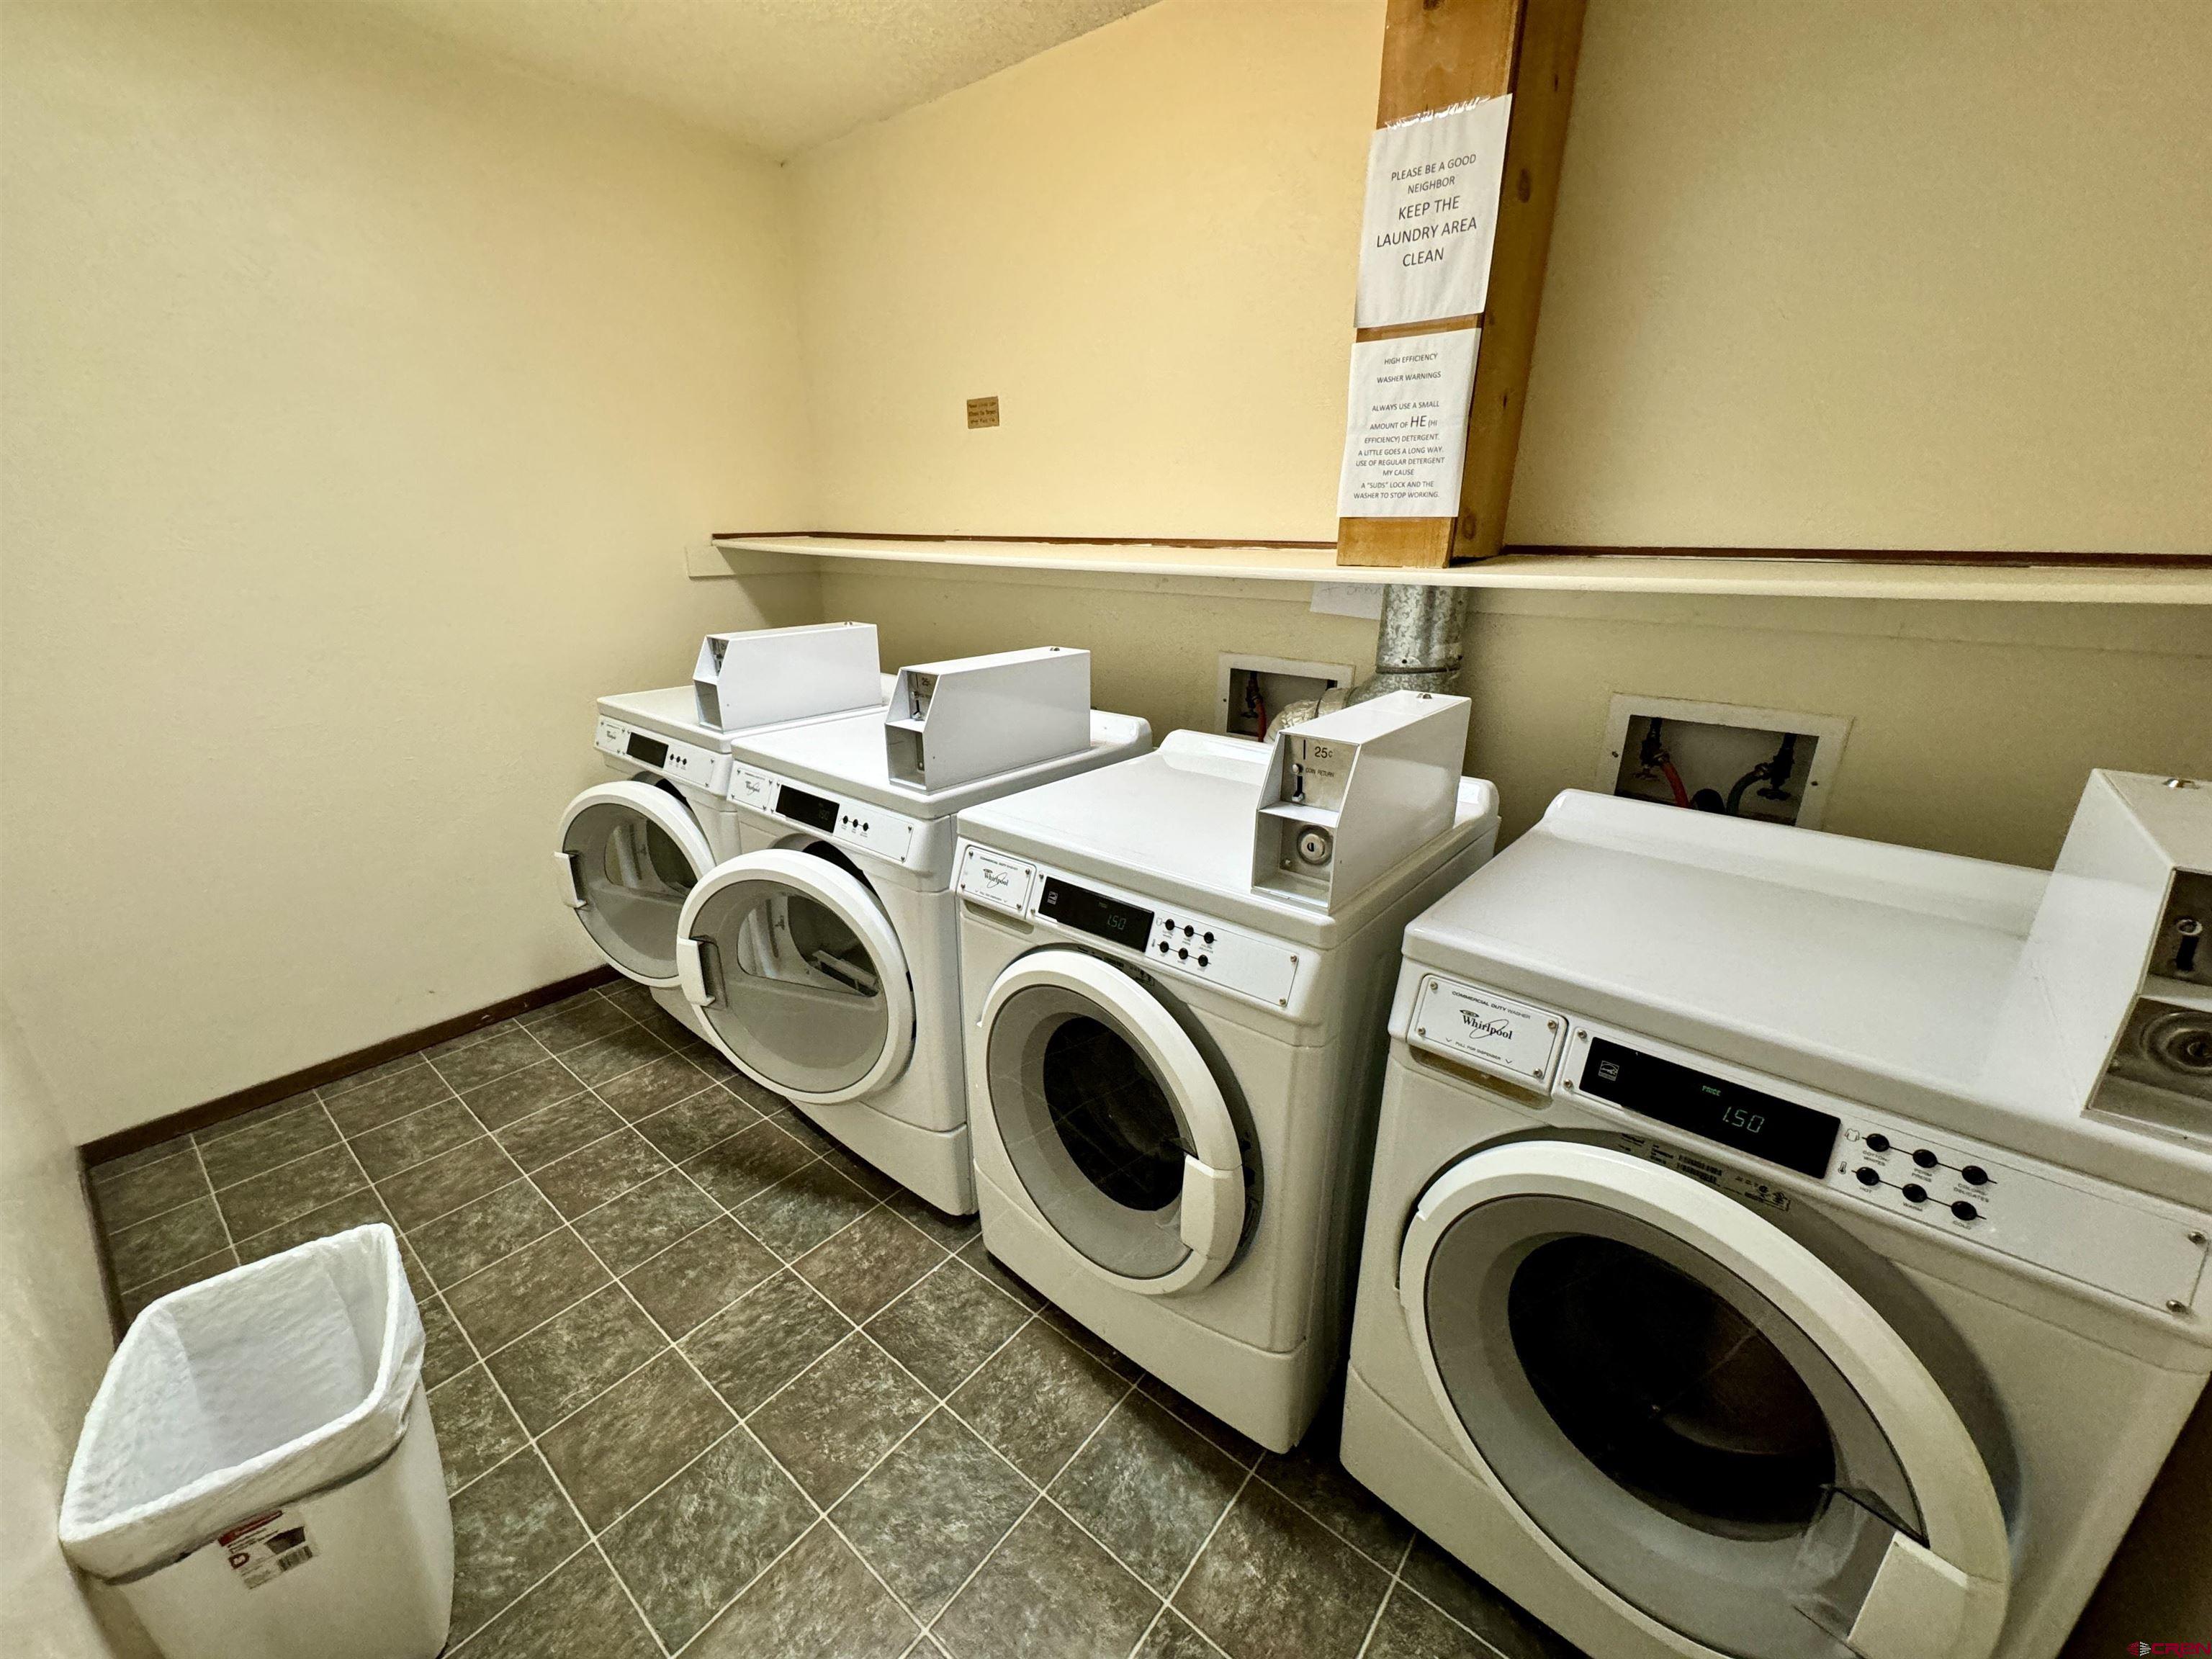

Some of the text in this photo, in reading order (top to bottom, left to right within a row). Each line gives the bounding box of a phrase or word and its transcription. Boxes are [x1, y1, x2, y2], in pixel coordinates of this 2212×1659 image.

[1391, 154, 1477, 181] PLEASE BE A GOOD
[1408, 176, 1455, 194] NEIGHBOR
[1398, 195, 1460, 220] KEEP THE
[1376, 217, 1477, 248] LAUNDRY AREA
[1402, 248, 1444, 267] CLEAN
[1402, 353, 1438, 364] EFFICIENCY
[1405, 371, 1442, 381] WARNINGS
[1372, 403, 1398, 412] ALWAYS
[1419, 400, 1439, 409] SMALL
[1370, 422, 1398, 431] AMOUNT
[1410, 415, 1427, 428] HE
[1428, 420, 1438, 428] (HI
[1364, 433, 1439, 444] EFFICIENCY) DETERGENT.
[1408, 457, 1445, 465] DETERGENT
[1452, 991, 1489, 1006] COMMERCIAL
[1507, 1009, 1531, 1019] WASHER
[1463, 1015, 1513, 1040] Whirlpool
[1701, 1085, 1721, 1096] PRICE
[1722, 1107, 1765, 1133] 1.50
[1912, 1172, 1932, 1182] PRESS
[1903, 1202, 1923, 1212] WARM
[1953, 1220, 1972, 1230] COLD
